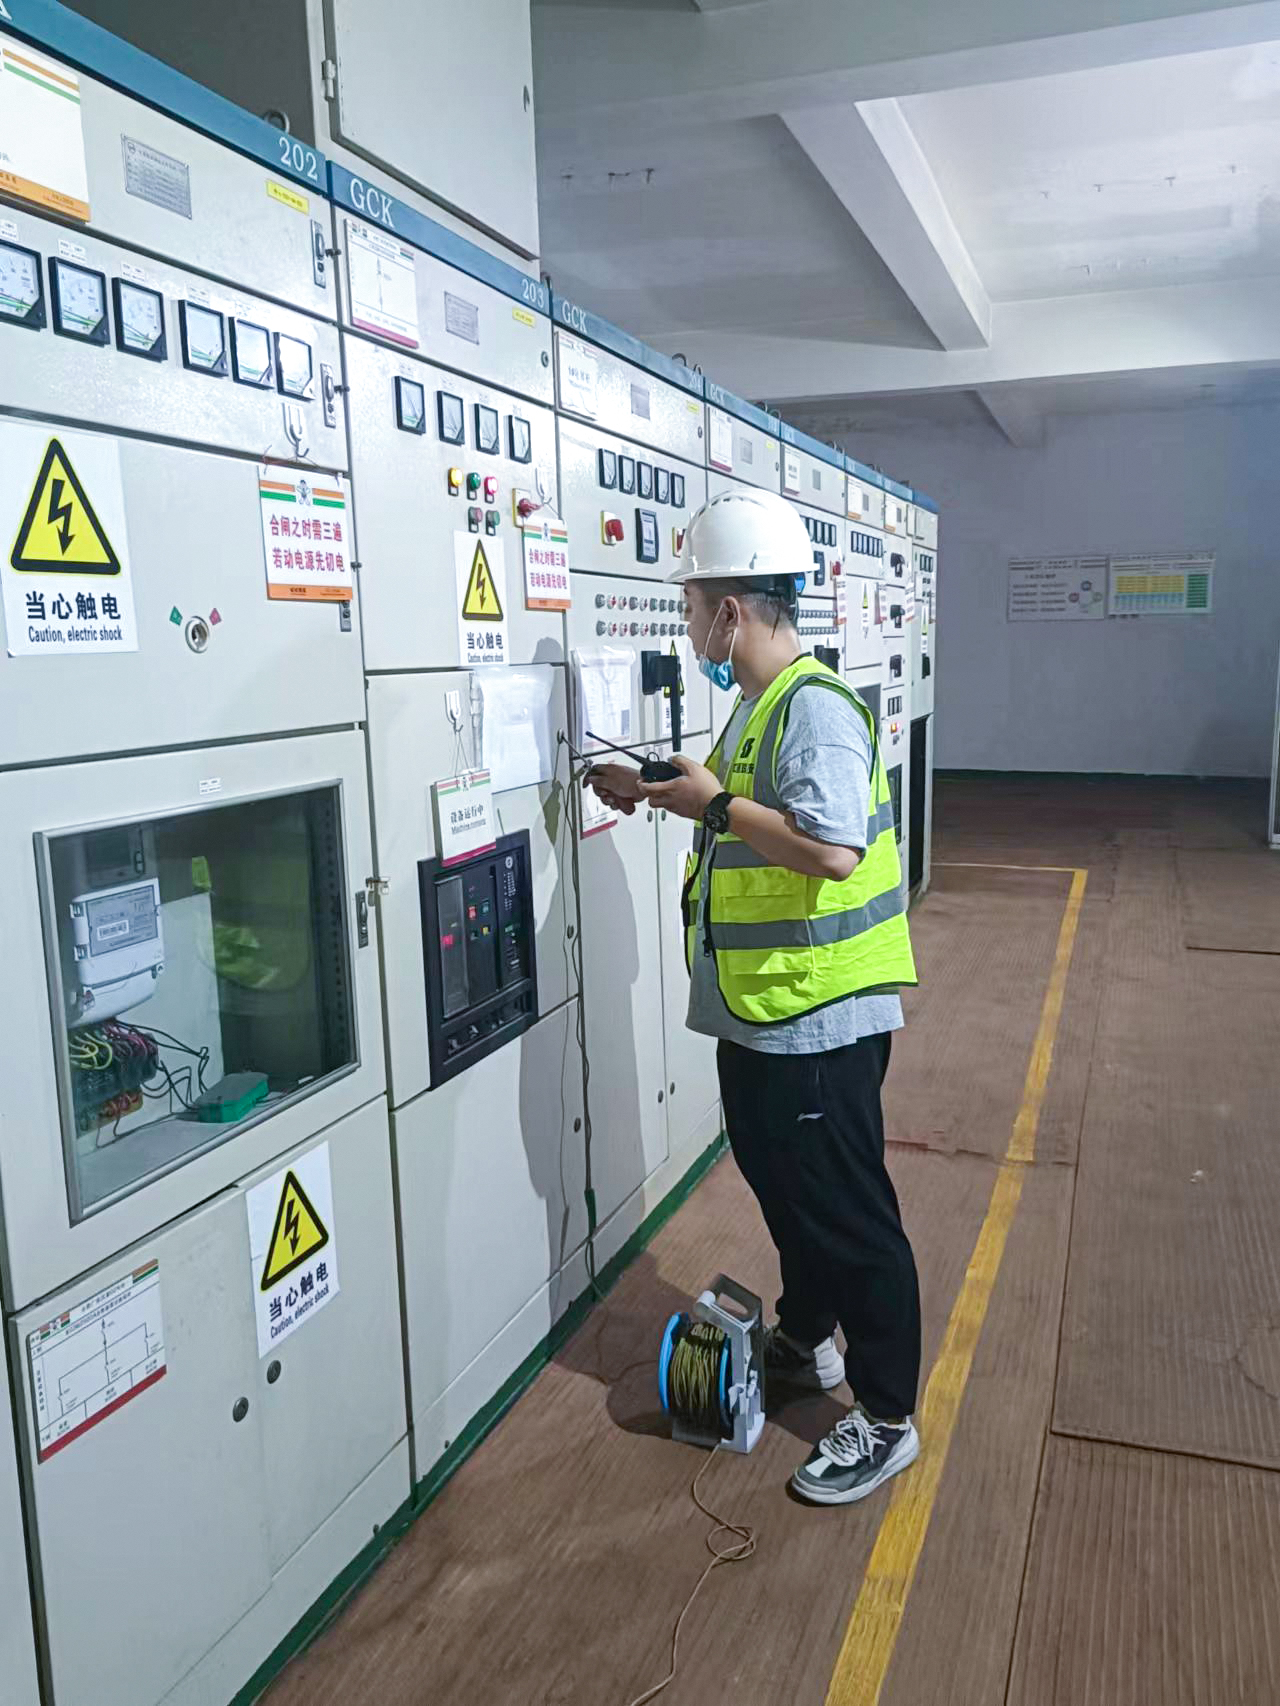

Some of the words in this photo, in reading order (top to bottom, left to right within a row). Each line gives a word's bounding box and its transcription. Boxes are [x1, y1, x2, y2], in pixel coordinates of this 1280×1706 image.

[279, 136, 318, 181] 202
[350, 178, 395, 228] GCK
[522, 279, 544, 308] 203
[562, 300, 587, 334] GCK
[25, 590, 121, 620] 当心触电
[28, 625, 66, 643] Caution,
[67, 626, 98, 641] electric
[99, 625, 122, 641] shock
[466, 631, 504, 649] 当心触电
[269, 1262, 329, 1322] 当心触电
